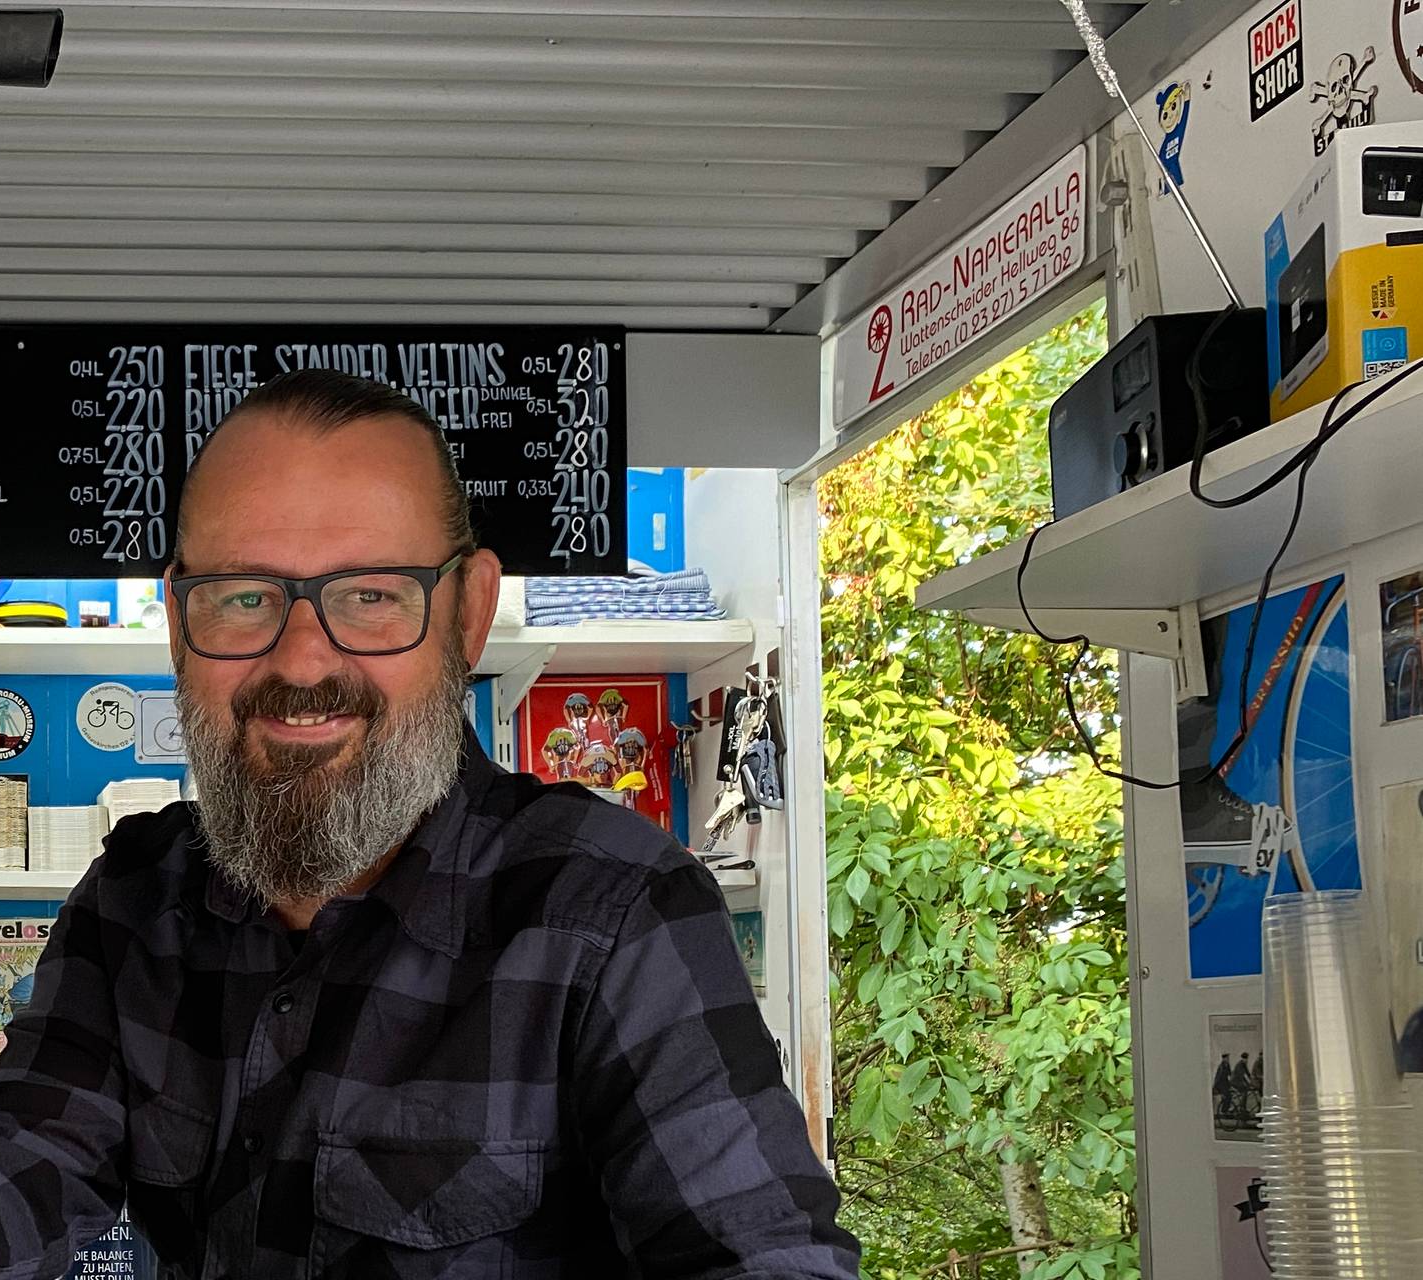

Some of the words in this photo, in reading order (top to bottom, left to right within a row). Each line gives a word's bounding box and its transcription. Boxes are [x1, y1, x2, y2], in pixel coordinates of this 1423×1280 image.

[1254, 4, 1297, 67] ROCK
[1255, 48, 1299, 110] SHOX
[899, 172, 1081, 334] RAD-NAPIERALLA
[899, 275, 998, 357] Wattenscheider
[1001, 233, 1058, 287] Hellweg
[1061, 216, 1080, 241] 86
[905, 339, 951, 380] Telefon
[972, 306, 989, 336] 23
[992, 290, 1016, 323] 27)
[1019, 279, 1028, 305] 5
[1052, 245, 1073, 276] 02
[398, 342, 507, 388] VELTINS
[481, 386, 537, 401] DUNKEL
[482, 412, 513, 429] FREI
[74, 1250, 89, 1262] DIE
[91, 1249, 134, 1262] BALANCE
[82, 1262, 95, 1274] ZU
[97, 1262, 135, 1274] HALTEN,
